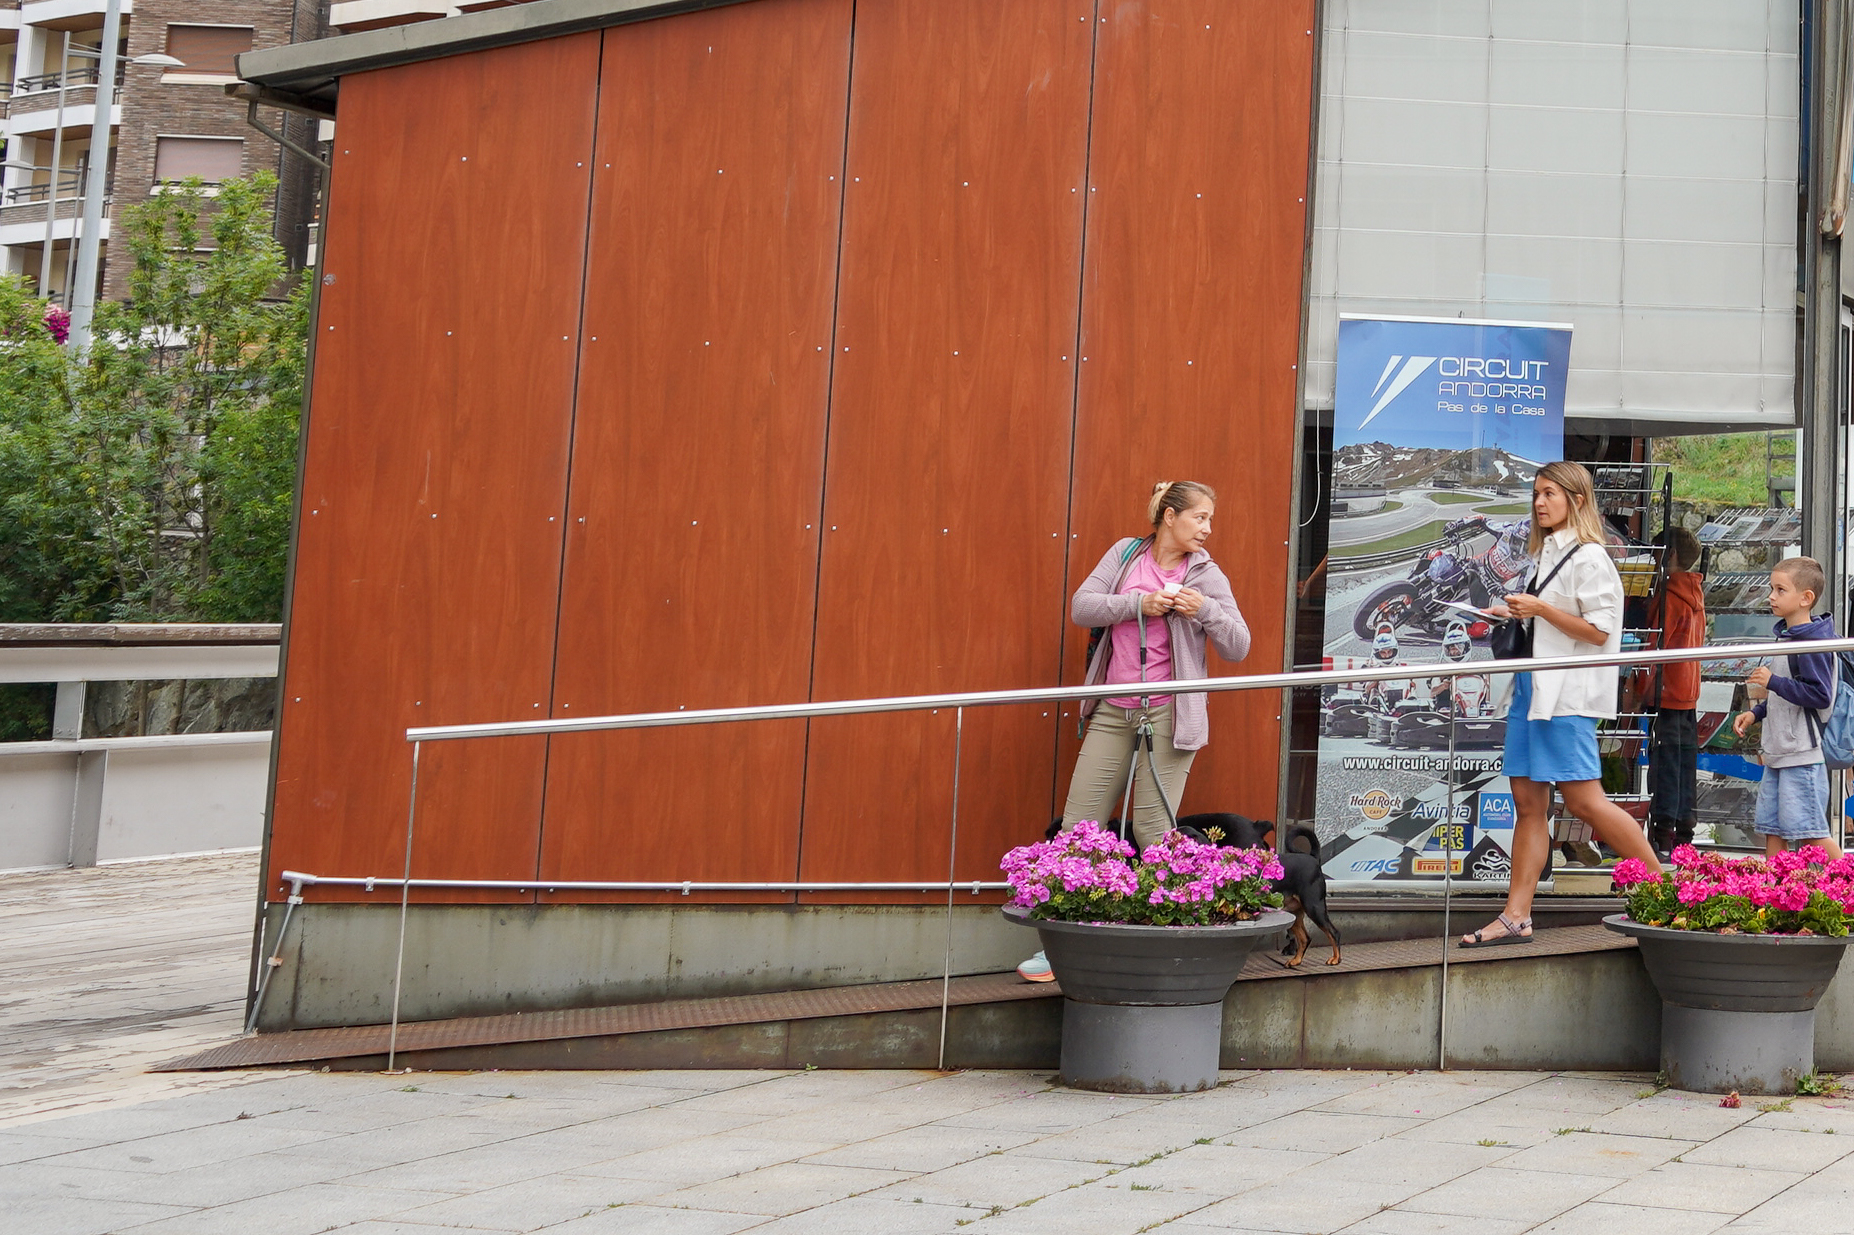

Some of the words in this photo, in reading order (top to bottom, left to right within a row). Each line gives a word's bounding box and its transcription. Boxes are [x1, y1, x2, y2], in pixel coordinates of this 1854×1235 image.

[1438, 356, 1549, 381] CIRCUIT
[1438, 381, 1546, 400] ANDORRA
[1437, 401, 1464, 413] Pas
[1470, 401, 1488, 414] de
[1494, 402, 1506, 414] la
[1511, 403, 1546, 416] Casa
[1343, 755, 1503, 772] www.circuit-andorra.c
[1350, 795, 1376, 806] Hard
[1377, 795, 1402, 809] Rock
[1483, 798, 1511, 812] ACA
[1439, 838, 1464, 850] PAS
